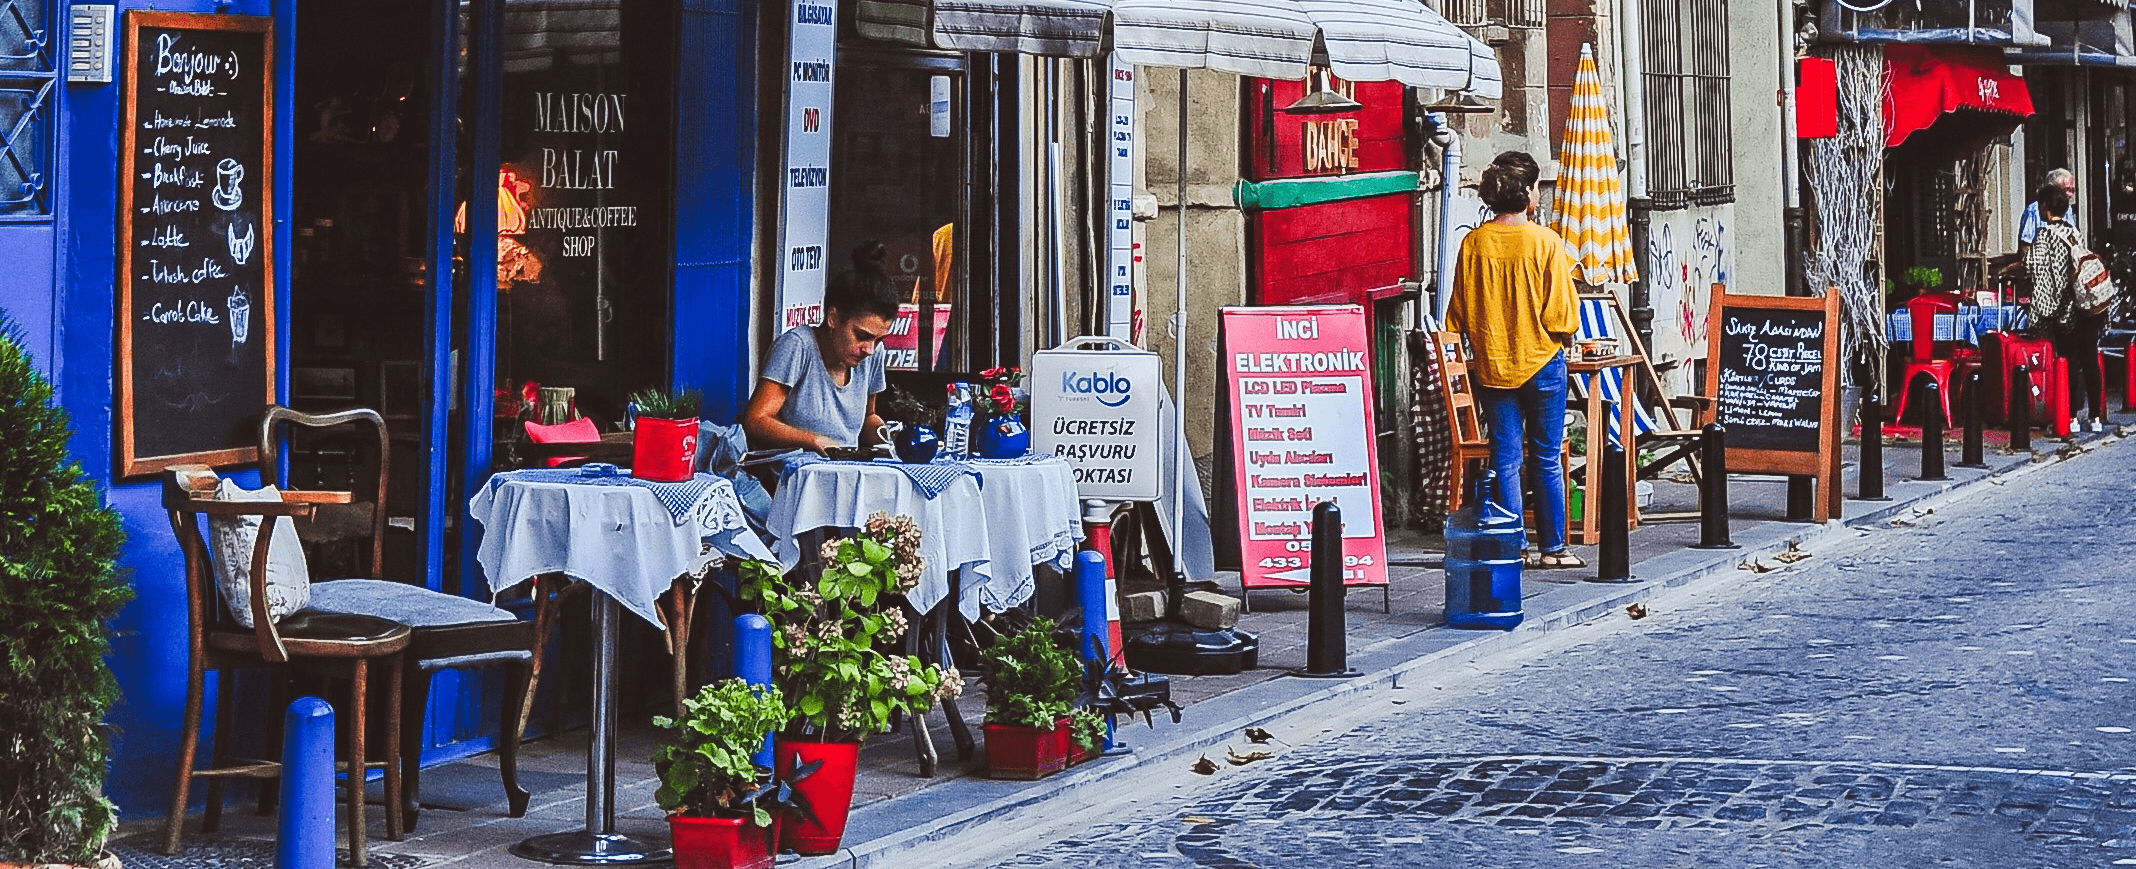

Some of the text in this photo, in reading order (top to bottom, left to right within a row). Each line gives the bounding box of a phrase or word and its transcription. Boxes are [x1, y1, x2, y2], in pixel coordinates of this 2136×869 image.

[155, 33, 221, 84] Bonjour
[793, 61, 802, 82] PC
[533, 91, 628, 133] MAISON
[803, 107, 821, 133] DVD
[184, 136, 211, 156] Juice
[540, 147, 618, 190] BALAT
[528, 206, 637, 233] ANTIQUE&COFFEE
[562, 235, 595, 258] SHOP
[791, 245, 822, 272] OTO TEYP
[1276, 316, 1319, 340] İNCİ
[1235, 347, 1366, 373] ELEKTRONİK
[1742, 343, 1768, 370] 78
[1061, 371, 1131, 394] Kablo
[1244, 380, 1270, 395] LCD
[1273, 380, 1298, 395] LED
[1245, 404, 1263, 418] TV
[1053, 416, 1136, 436] ÜCRETSİZ
[1054, 443, 1137, 463] BAŞVURU
[1072, 467, 1133, 484] OKTASI
[1258, 556, 1303, 568] 433
